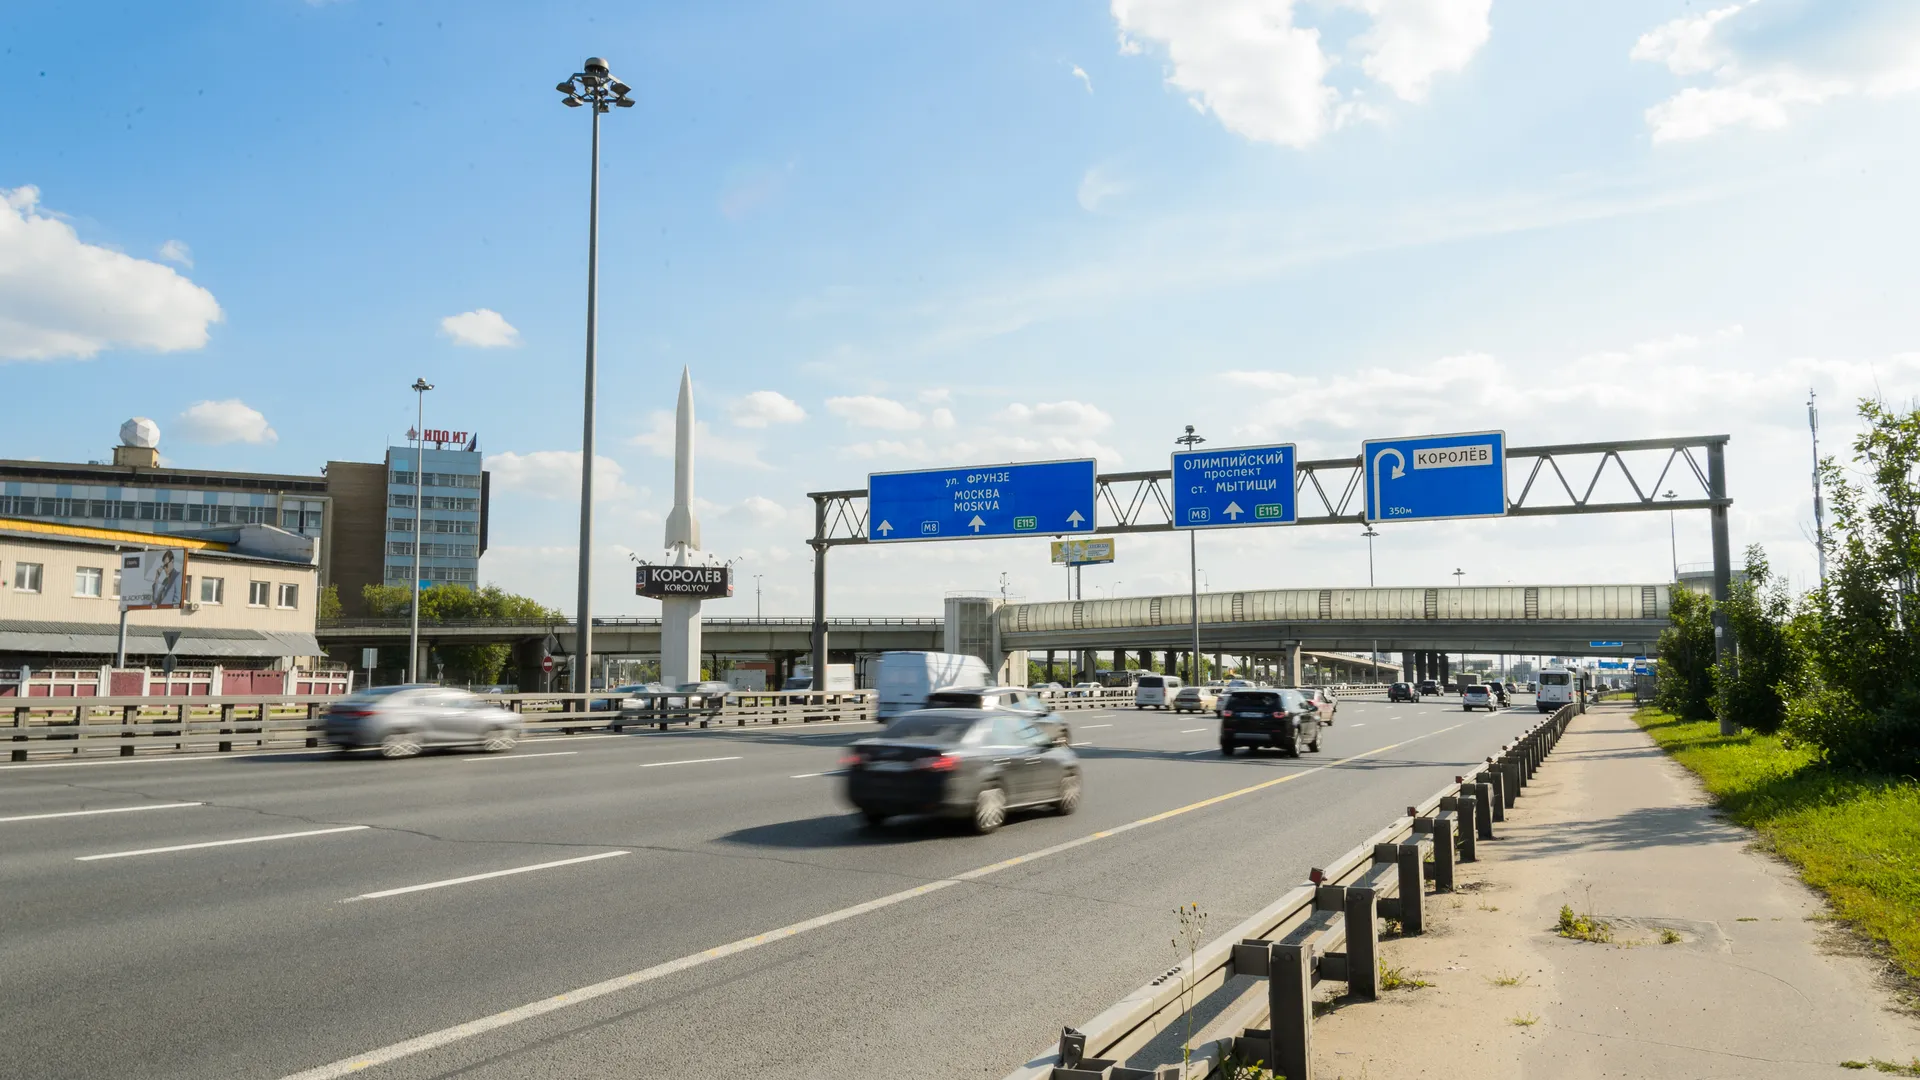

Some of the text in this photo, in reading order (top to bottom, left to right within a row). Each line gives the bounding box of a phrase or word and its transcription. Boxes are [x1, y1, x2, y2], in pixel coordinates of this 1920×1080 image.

[424, 429, 468, 443] НПО ИТ
[1183, 450, 1284, 470] ОЛИМПИЙСКИЙ
[1418, 447, 1488, 464] КОРОЛЁВ
[945, 472, 1010, 487] ул. ФРУНЗЕ
[1204, 467, 1262, 480] проспект
[1191, 479, 1277, 494] ст. МЫТИЩИ
[954, 488, 1000, 500] МОСКВА
[954, 500, 1000, 512] MOSKVA
[1258, 506, 1280, 517] E115
[1389, 506, 1412, 515] 350м
[1191, 510, 1207, 519] M8
[923, 522, 937, 532] M8
[1016, 518, 1035, 528] E115
[652, 567, 722, 583] КОРОЛЁВ
[664, 584, 710, 592] KOROLYOV
